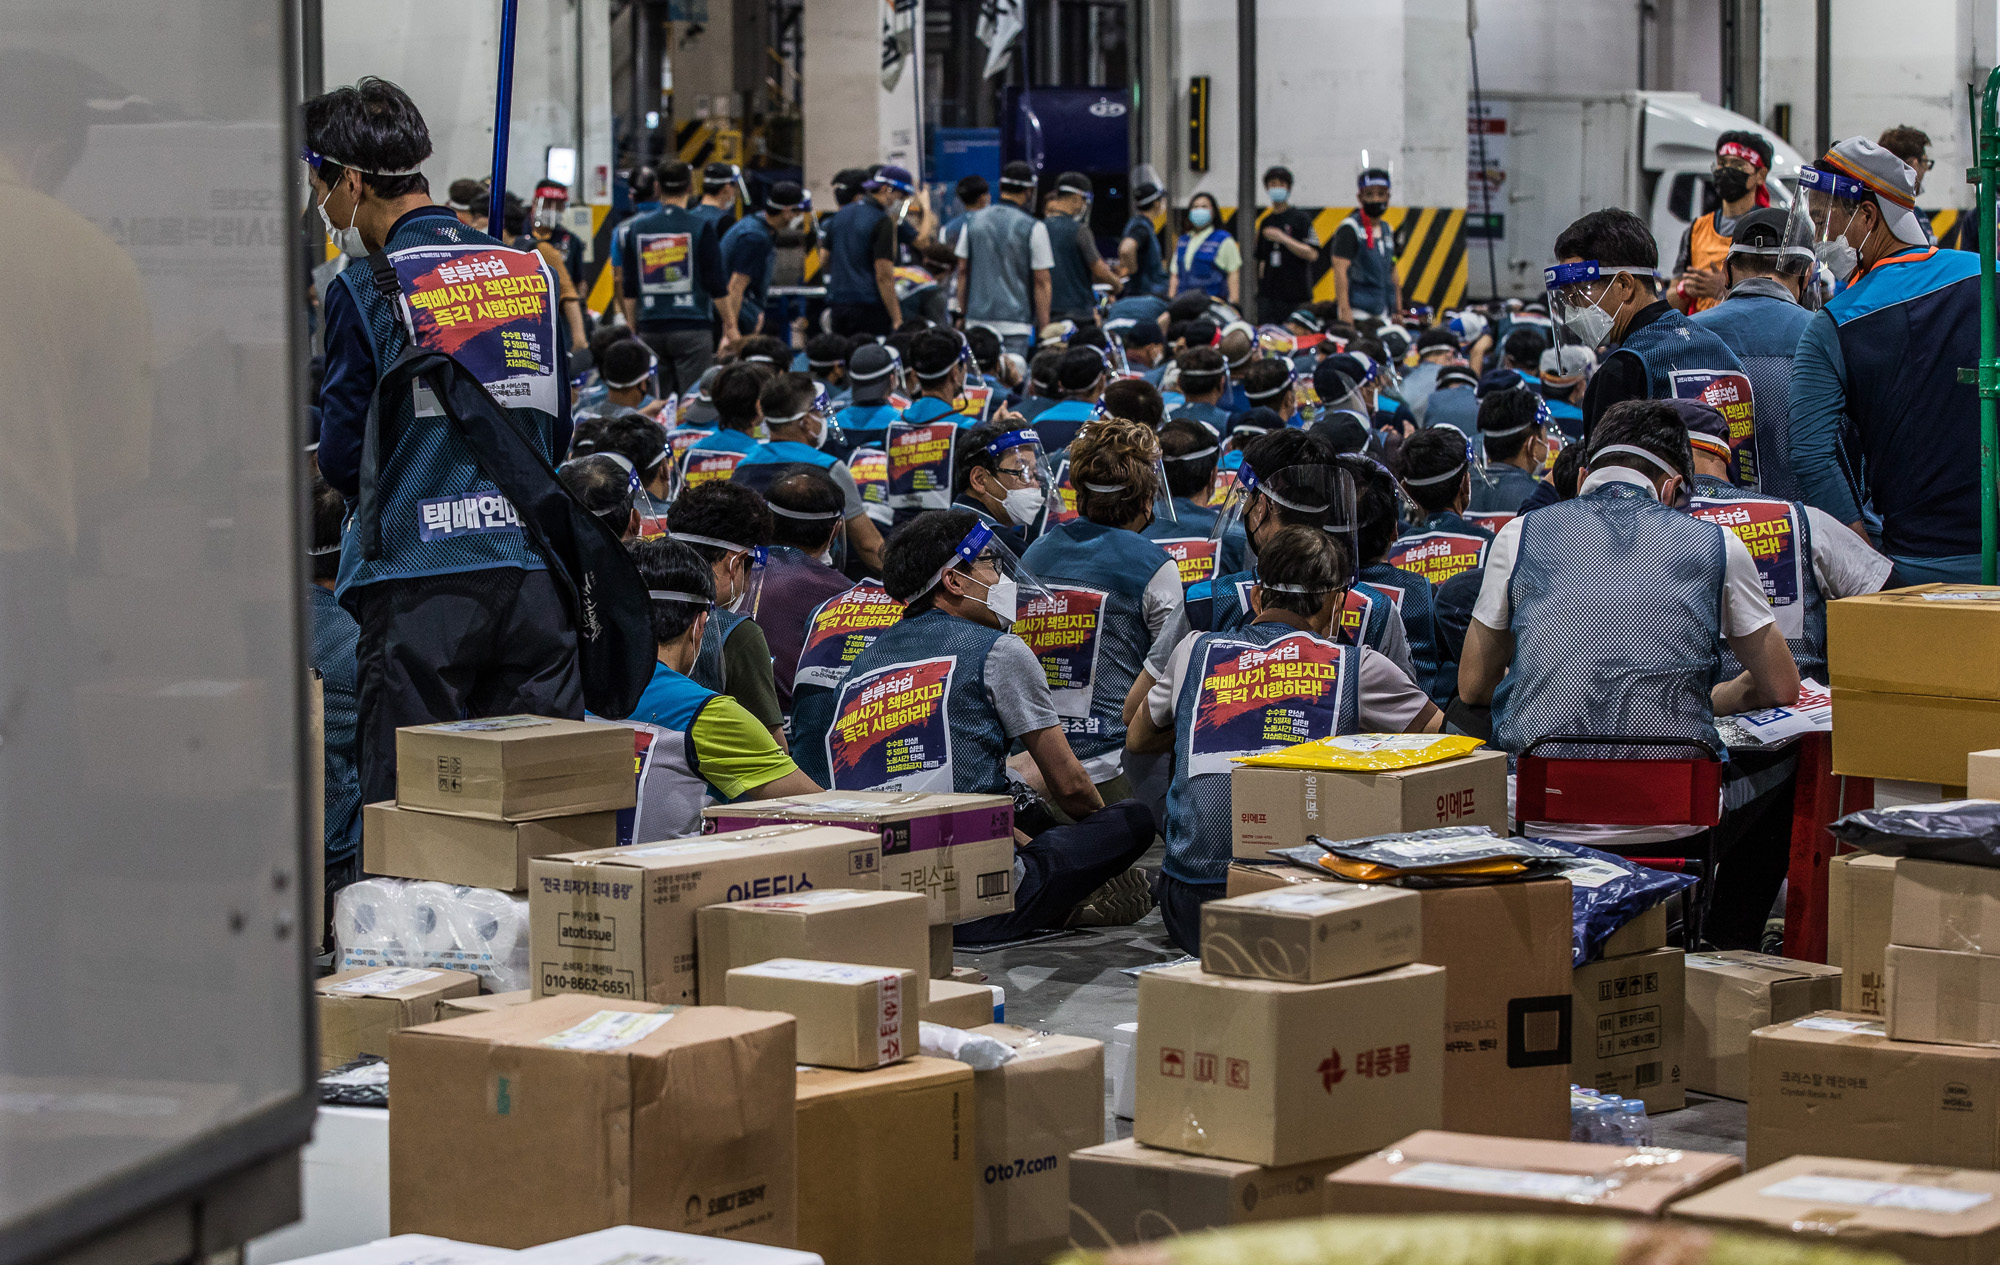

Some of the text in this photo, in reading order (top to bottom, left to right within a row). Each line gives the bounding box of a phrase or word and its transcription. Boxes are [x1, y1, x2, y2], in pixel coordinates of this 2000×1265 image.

[438, 256, 510, 284] 분류작업
[410, 275, 548, 309] 택배사가 책임지고
[433, 296, 542, 327] 즉각 시행하라!
[1704, 382, 1739, 407] 분류작업
[1405, 541, 1451, 562] 분류작업
[1429, 553, 1477, 569] 책임지고
[1178, 557, 1213, 572] 임지고
[1027, 596, 1068, 617] 분류작업
[817, 615, 840, 632] 즉각
[1047, 614, 1096, 630] 책임지고
[1034, 630, 1084, 647] 시행하라!
[1204, 662, 1336, 691] 택배사가 책임지고
[860, 673, 914, 706] 분류작업
[1216, 680, 1322, 705] 즉각 시행하라!
[835, 701, 885, 733] 택배사가
[887, 682, 943, 710] 책임지고
[842, 706, 931, 744] 즉각 시행하라!
[1060, 717, 1100, 734] 동조합
[1265, 716, 1273, 724] 주
[886, 749, 893, 757] 주
[1436, 788, 1475, 824] 위메프
[1241, 813, 1267, 824] 위메프
[854, 852, 874, 870] 정품
[563, 879, 590, 896] 최저가
[592, 881, 611, 897] 최대
[901, 865, 957, 899] 크림수프
[562, 926, 612, 942] atotissue
[545, 974, 631, 995] 010-8662-6651
[1356, 1043, 1411, 1079] 태풍몰
[1780, 1071, 1822, 1087] 크리스탈
[1780, 1087, 1806, 1097] Crystal
[984, 1153, 1058, 1186] Oto7.com
